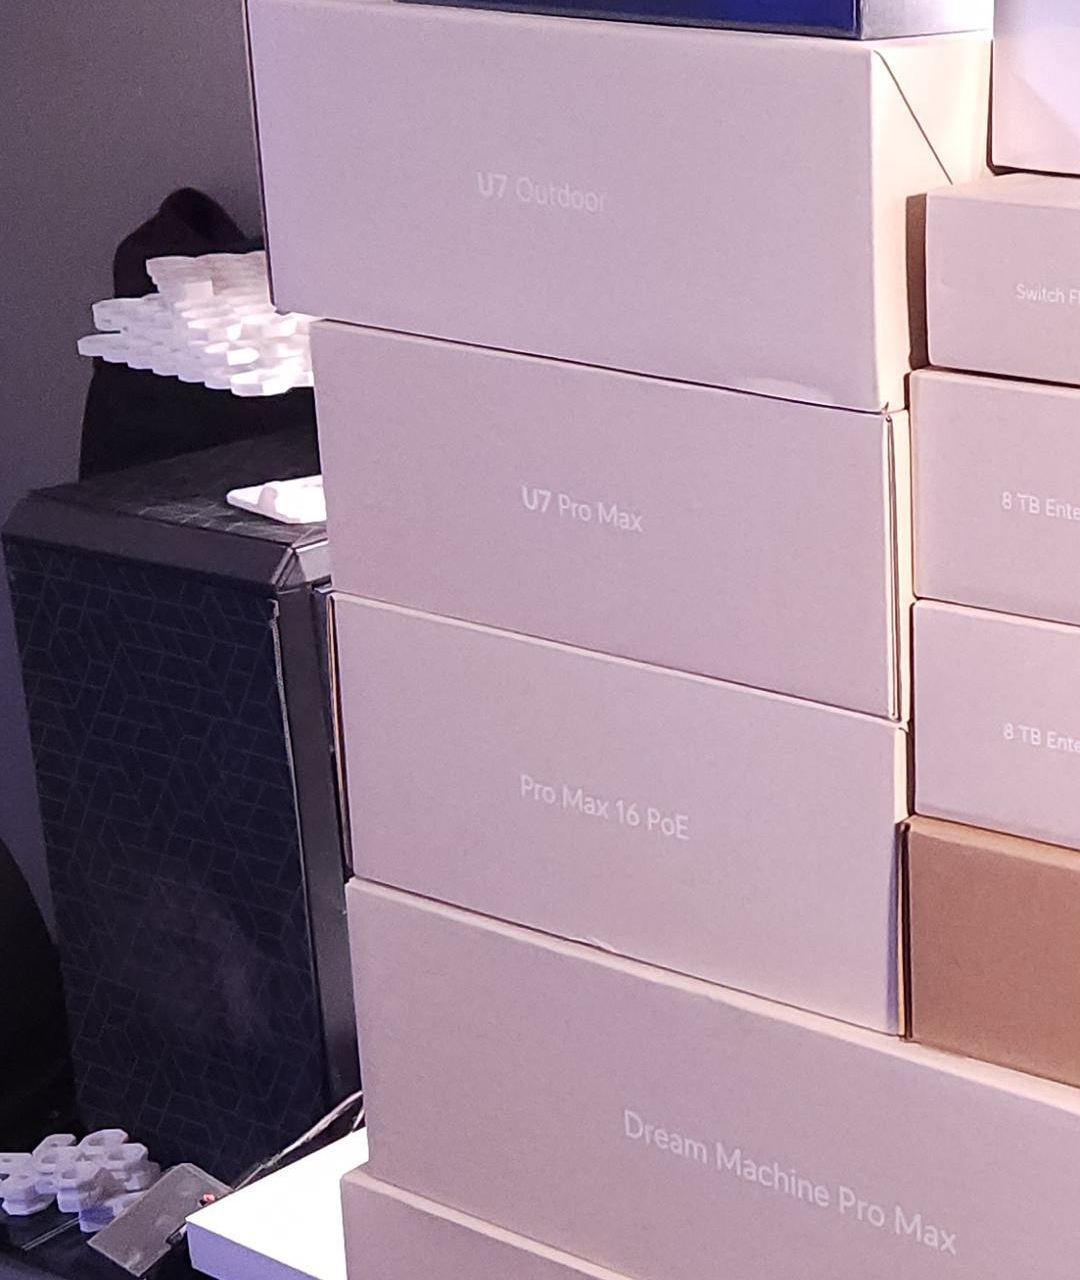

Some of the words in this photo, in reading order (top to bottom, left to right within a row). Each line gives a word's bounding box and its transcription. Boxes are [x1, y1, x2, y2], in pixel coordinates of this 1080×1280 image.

[477, 171, 507, 199] U7
[515, 175, 607, 213] Outdoor
[1016, 283, 1065, 305] Switch
[522, 485, 551, 513] U7
[558, 493, 592, 522] Pro
[598, 501, 644, 533] Max
[1002, 492, 1012, 510] 8
[1016, 493, 1041, 514] TB
[1003, 724, 1013, 740] 8
[1018, 725, 1042, 746] TB
[520, 774, 556, 805] Pro
[562, 783, 608, 818] Max
[615, 798, 640, 828] 16
[647, 807, 690, 840] PoE
[623, 1109, 708, 1163] Dream
[716, 1141, 831, 1207] Machine
[838, 1186, 885, 1228] Pro
[894, 1205, 957, 1255] Max
